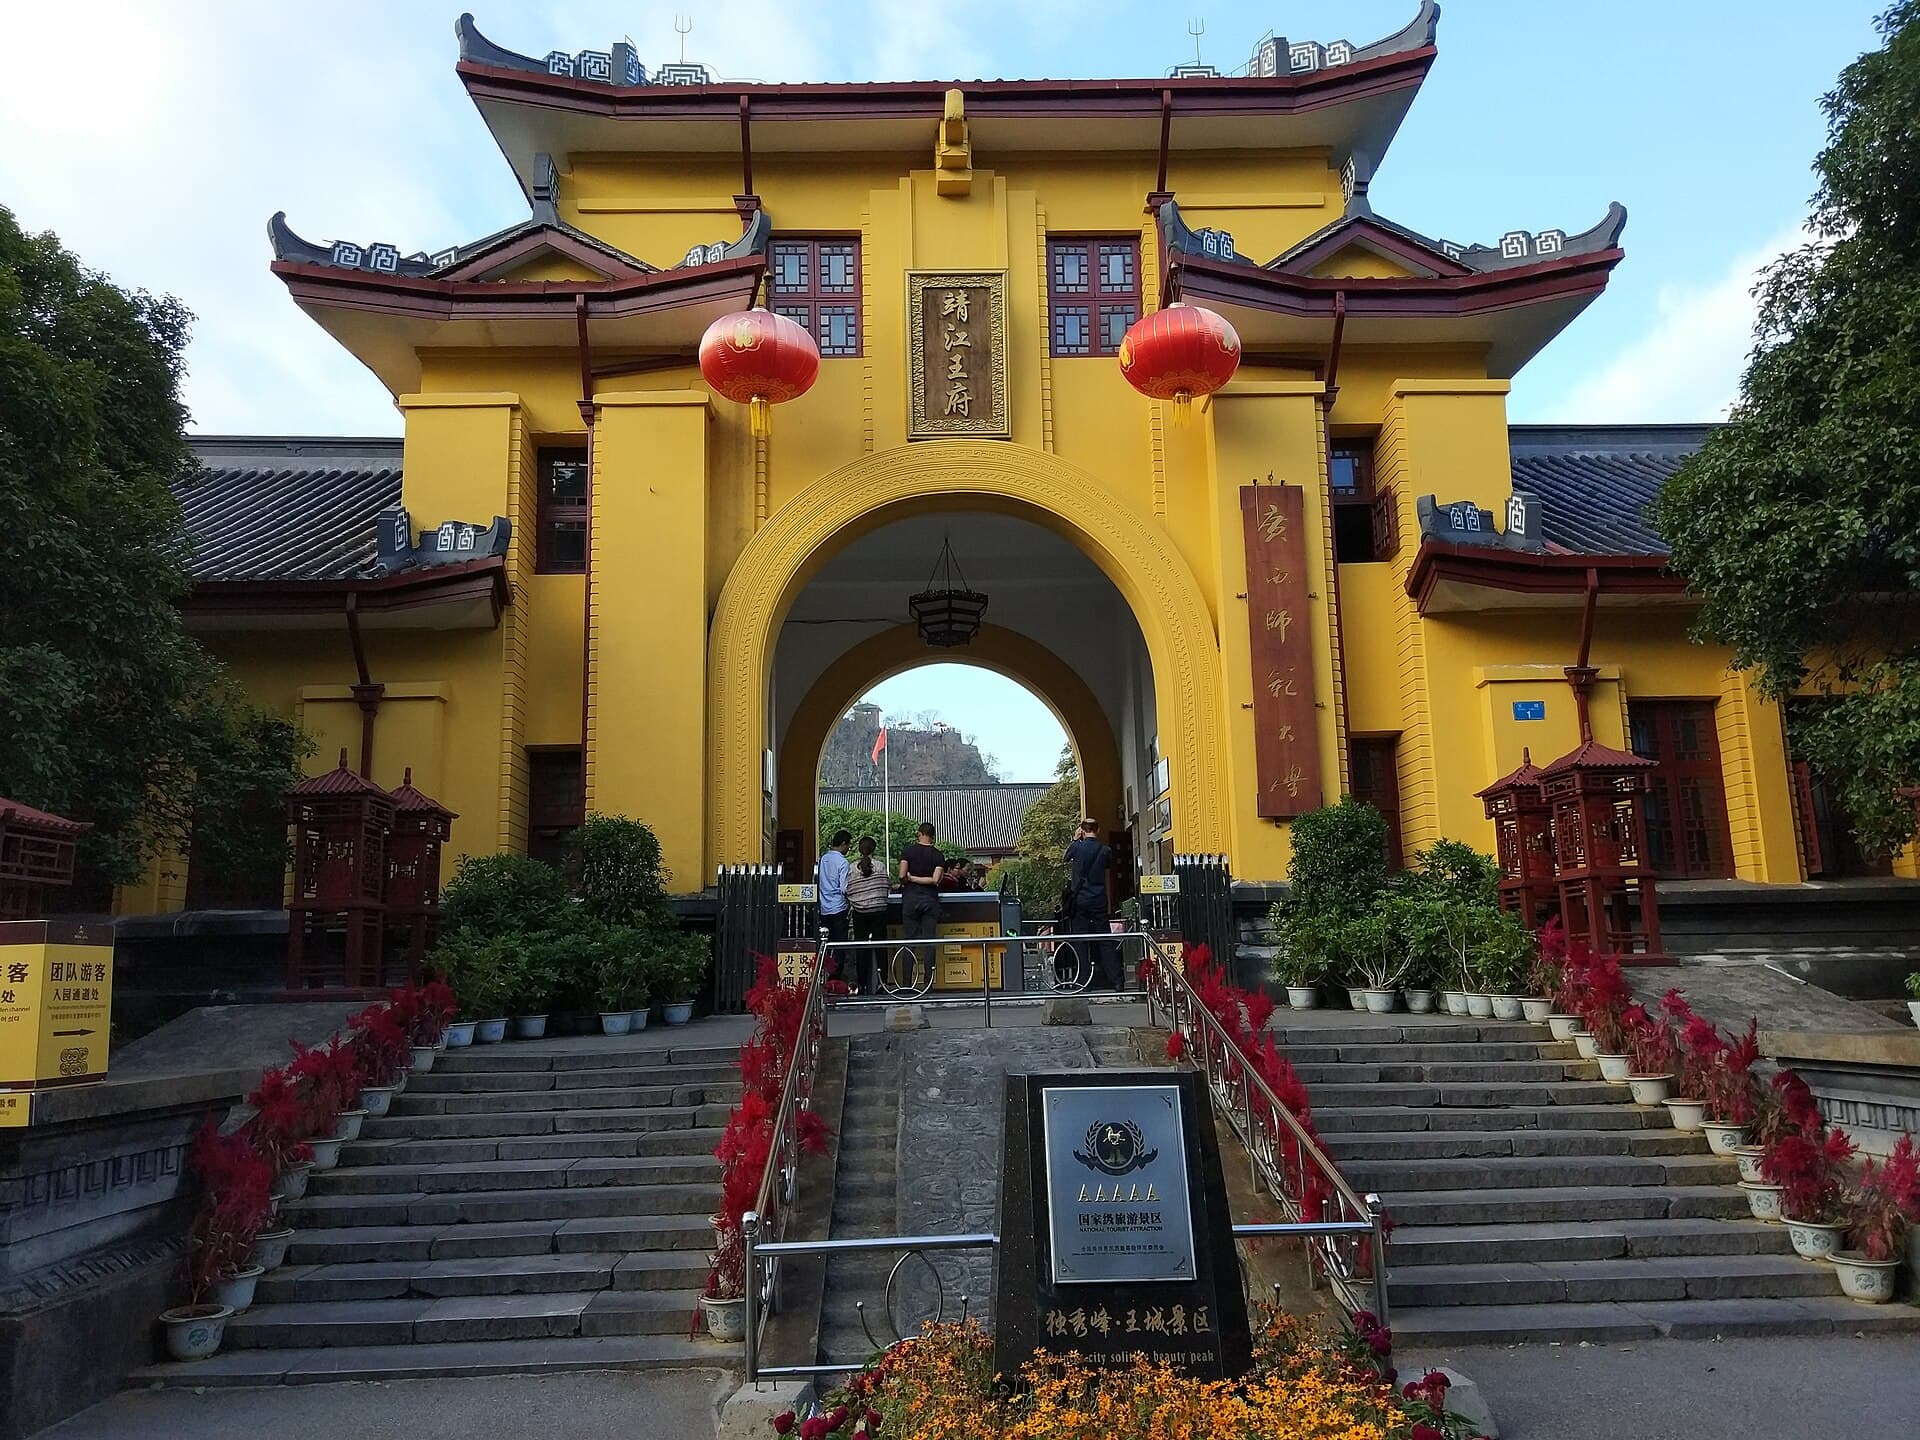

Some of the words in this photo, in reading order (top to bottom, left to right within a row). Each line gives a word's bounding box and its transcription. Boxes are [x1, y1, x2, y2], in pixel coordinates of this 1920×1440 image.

[941, 289, 973, 417] 靖江王府
[0, 962, 29, 984] 客
[50, 962, 106, 982] 团队游客
[52, 987, 99, 1001] 入园通道处
[1079, 1212, 1162, 1226] 国家级旅游景区
[1153, 1351, 1186, 1363] beauty
[1190, 1350, 1214, 1362] peak
